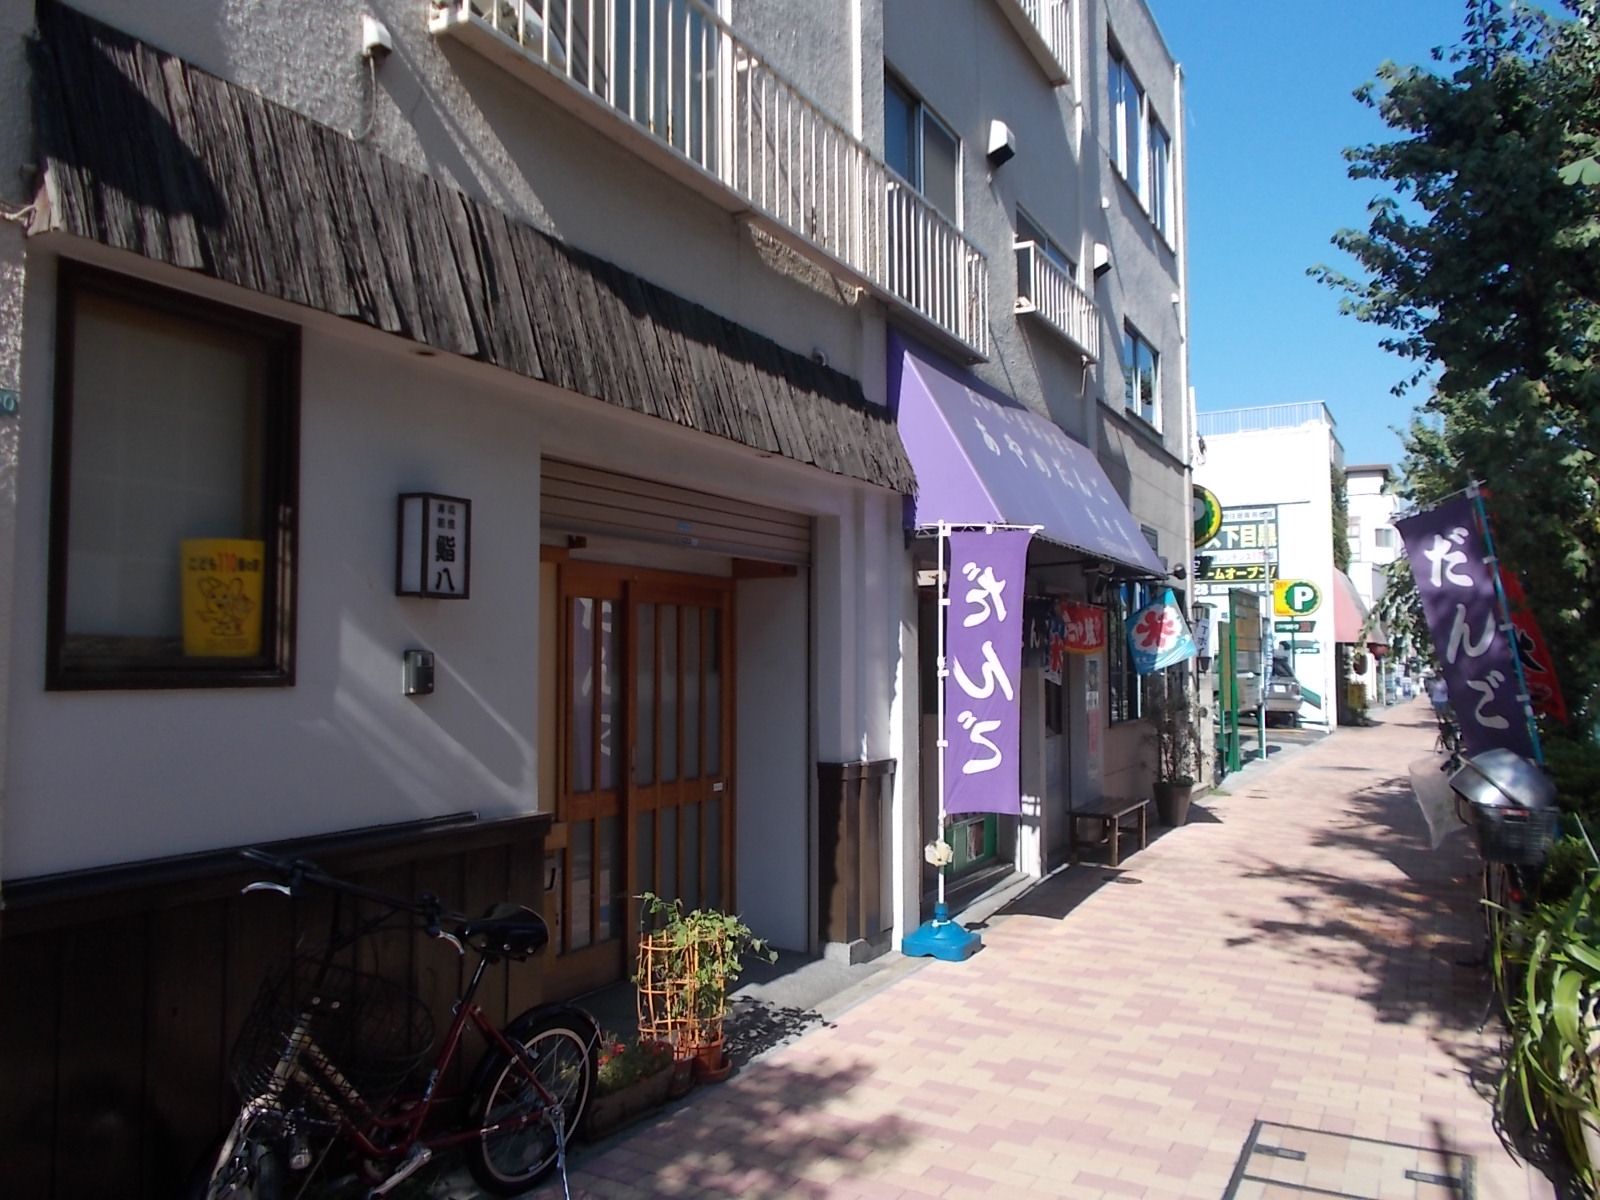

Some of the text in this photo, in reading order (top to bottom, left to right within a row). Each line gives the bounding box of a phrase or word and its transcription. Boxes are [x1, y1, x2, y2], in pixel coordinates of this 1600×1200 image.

[1293, 586, 1314, 610] P
[1423, 526, 1510, 730] だんご
